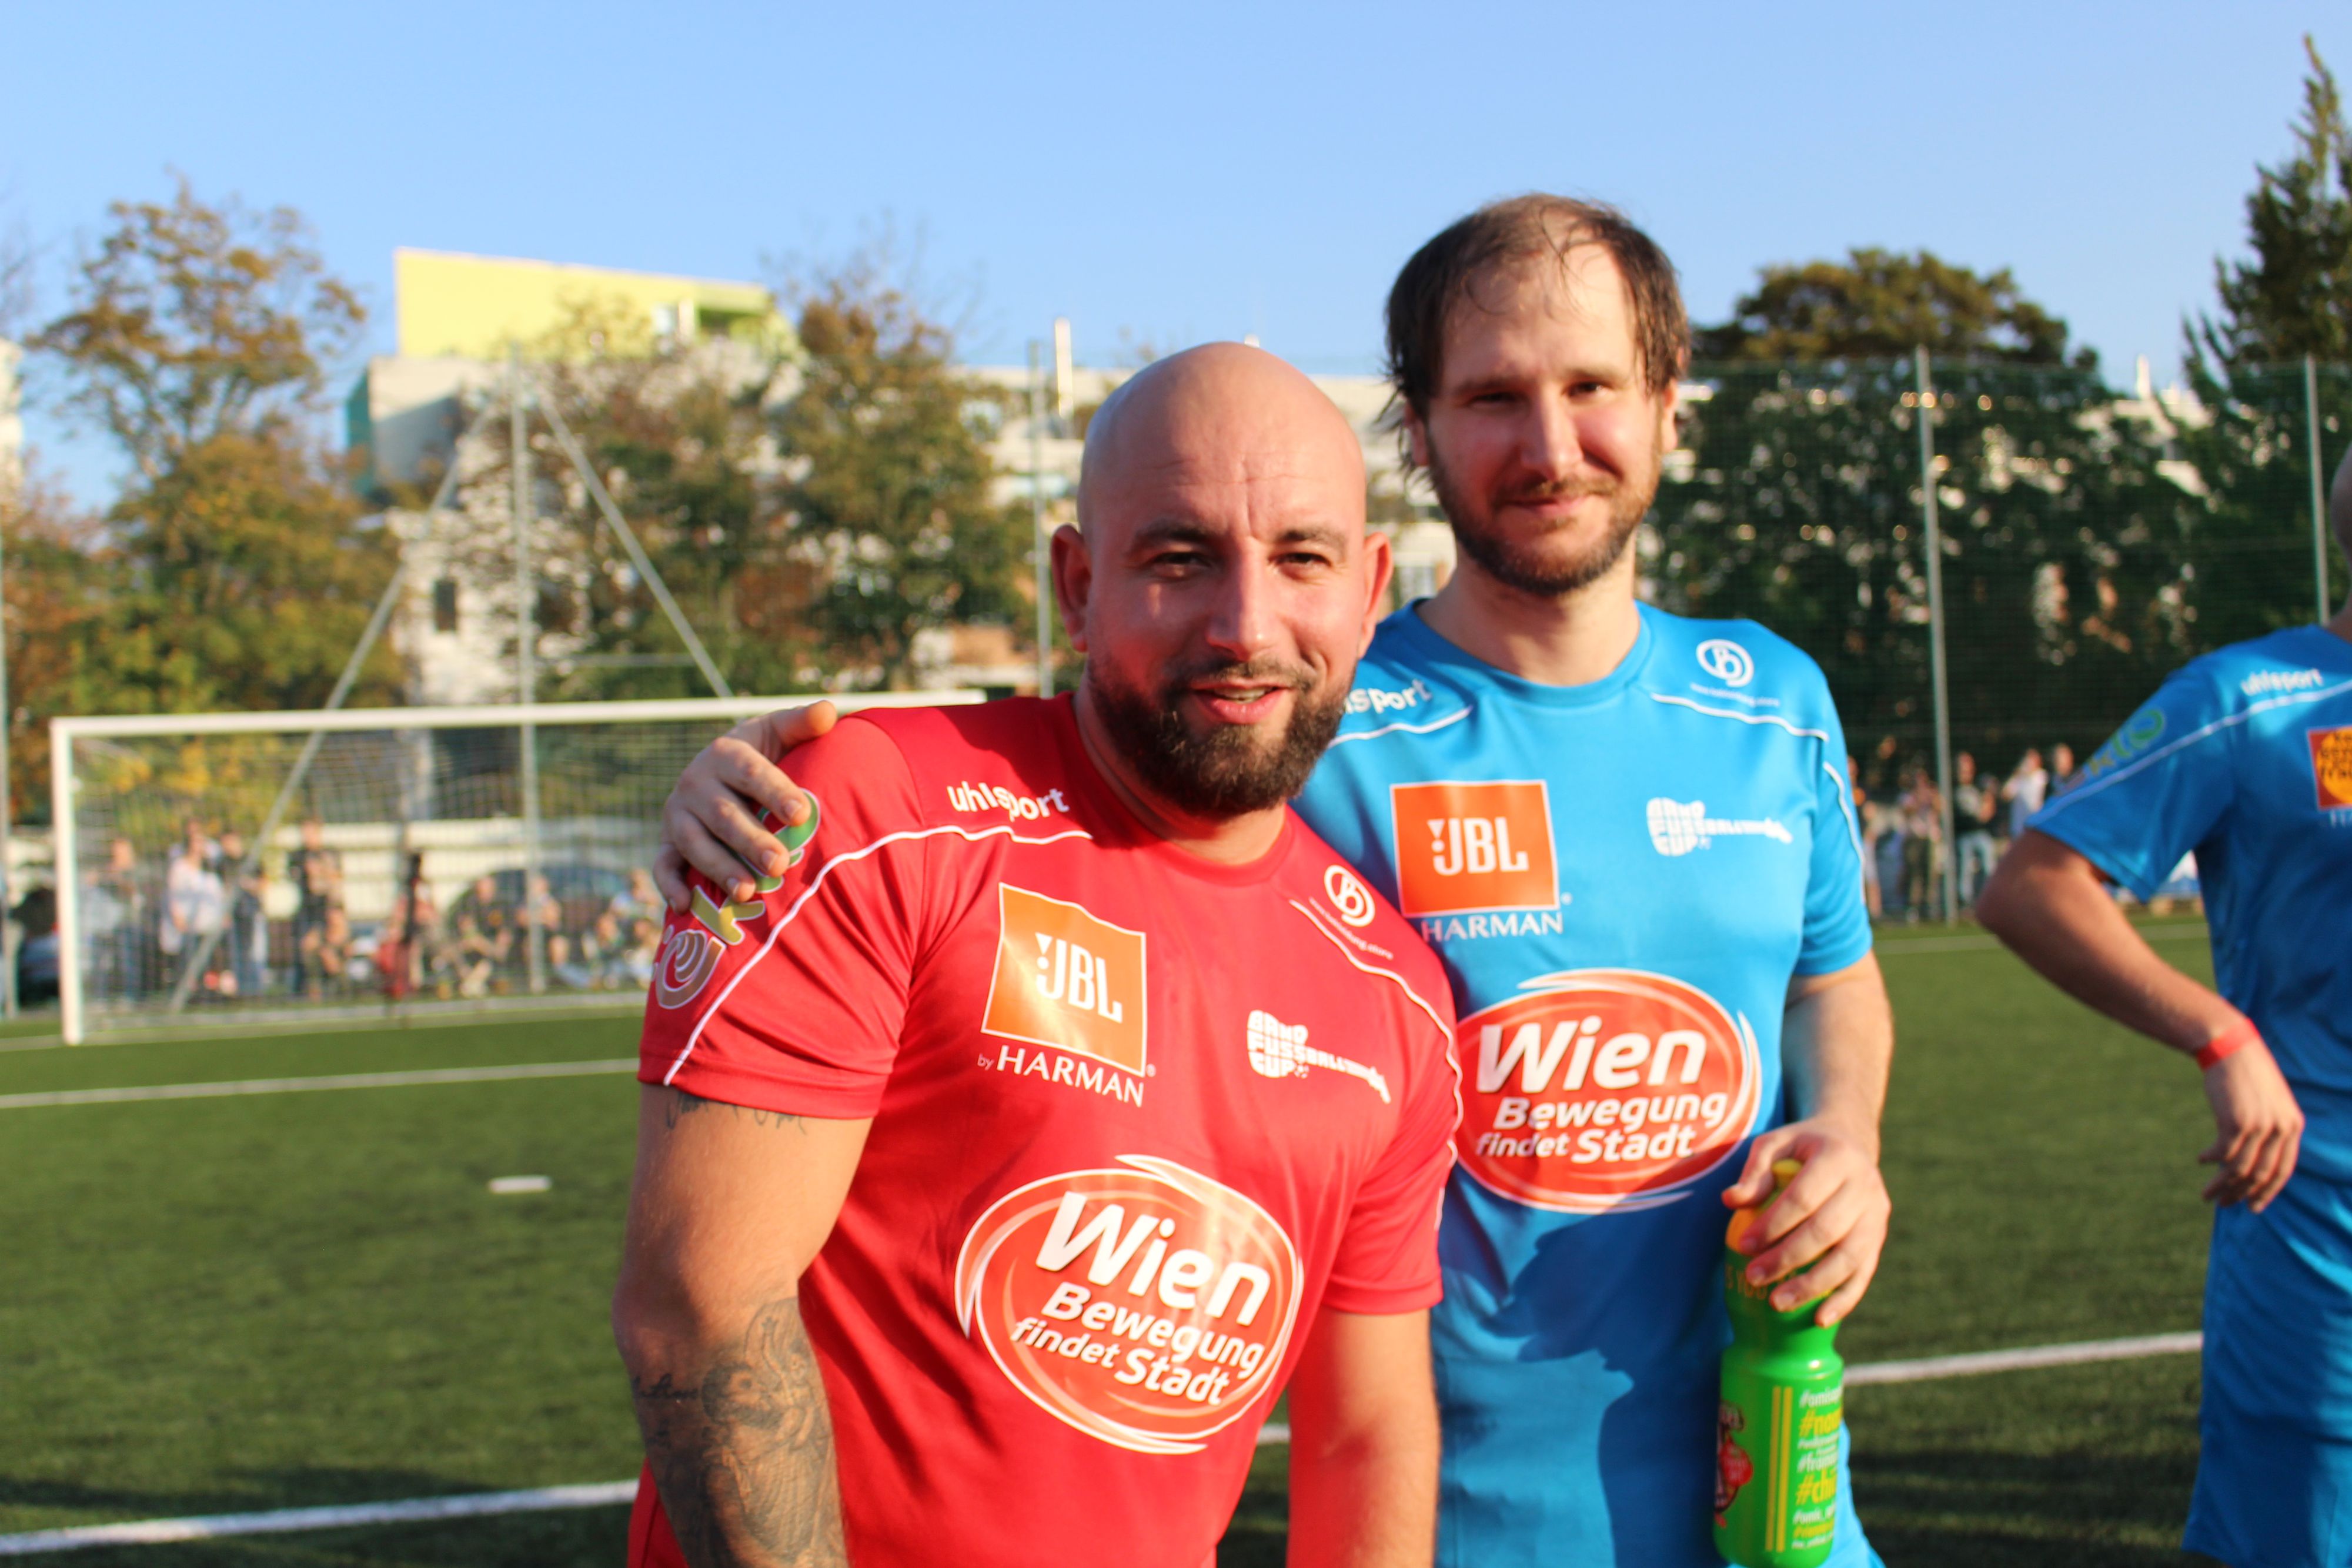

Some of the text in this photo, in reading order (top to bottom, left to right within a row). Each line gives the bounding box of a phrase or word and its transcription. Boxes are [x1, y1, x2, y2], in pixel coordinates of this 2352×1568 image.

[947, 781, 1070, 823] uhlsport
[1427, 817, 1529, 876] JBL
[1421, 912, 1563, 942] HARMAN
[1035, 932, 1122, 1024] JBL
[1247, 1009, 1308, 1045] BAND
[1247, 1029, 1346, 1073] FUSSBALL
[977, 1045, 1144, 1107] by HARMAN
[1248, 1051, 1296, 1078] CUP
[1476, 1015, 1706, 1094] Wien
[1493, 1092, 1728, 1134] Bewegung
[1476, 1124, 1696, 1164] findet Stadt
[1036, 1191, 1271, 1326] Wien
[1041, 1282, 1264, 1380] Bewegung
[1010, 1317, 1230, 1405] findet Stadt
